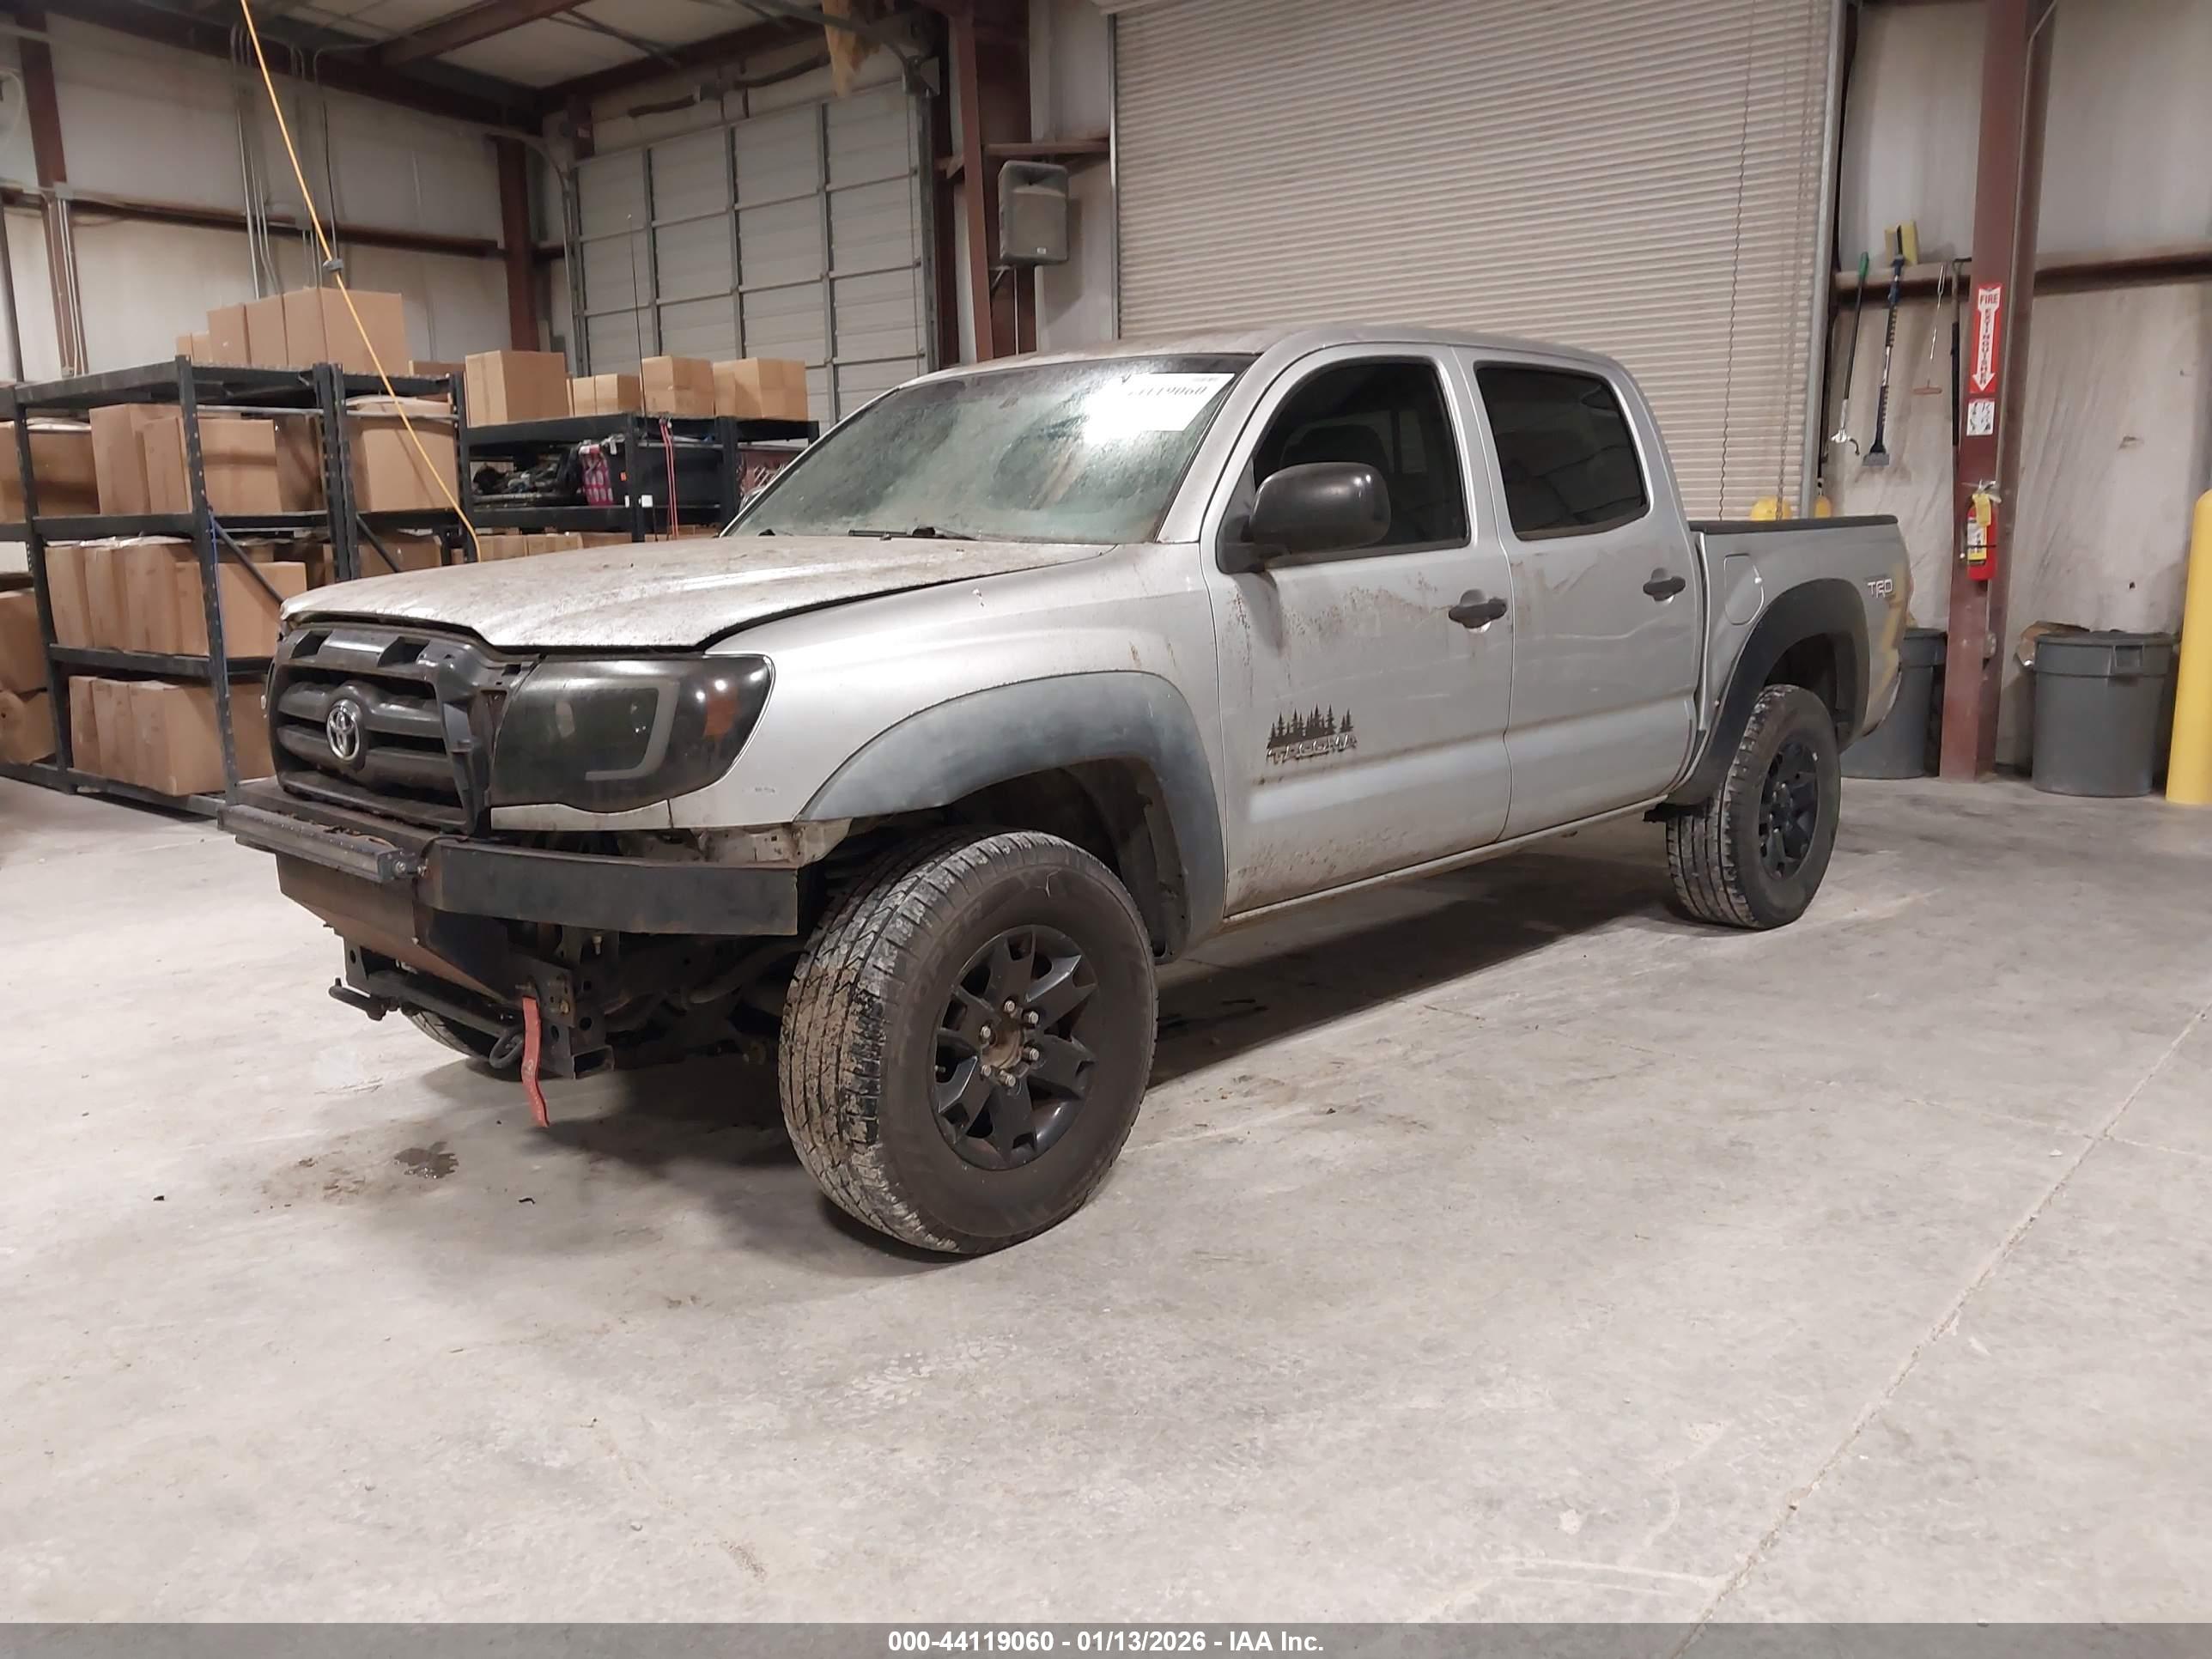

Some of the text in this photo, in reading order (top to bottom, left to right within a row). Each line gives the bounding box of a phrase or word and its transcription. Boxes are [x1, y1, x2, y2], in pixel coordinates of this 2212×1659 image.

[1979, 294, 1999, 304] FIRE
[1979, 308, 1991, 386] EXTINGUISHER
[1868, 579, 1893, 598] TRD
